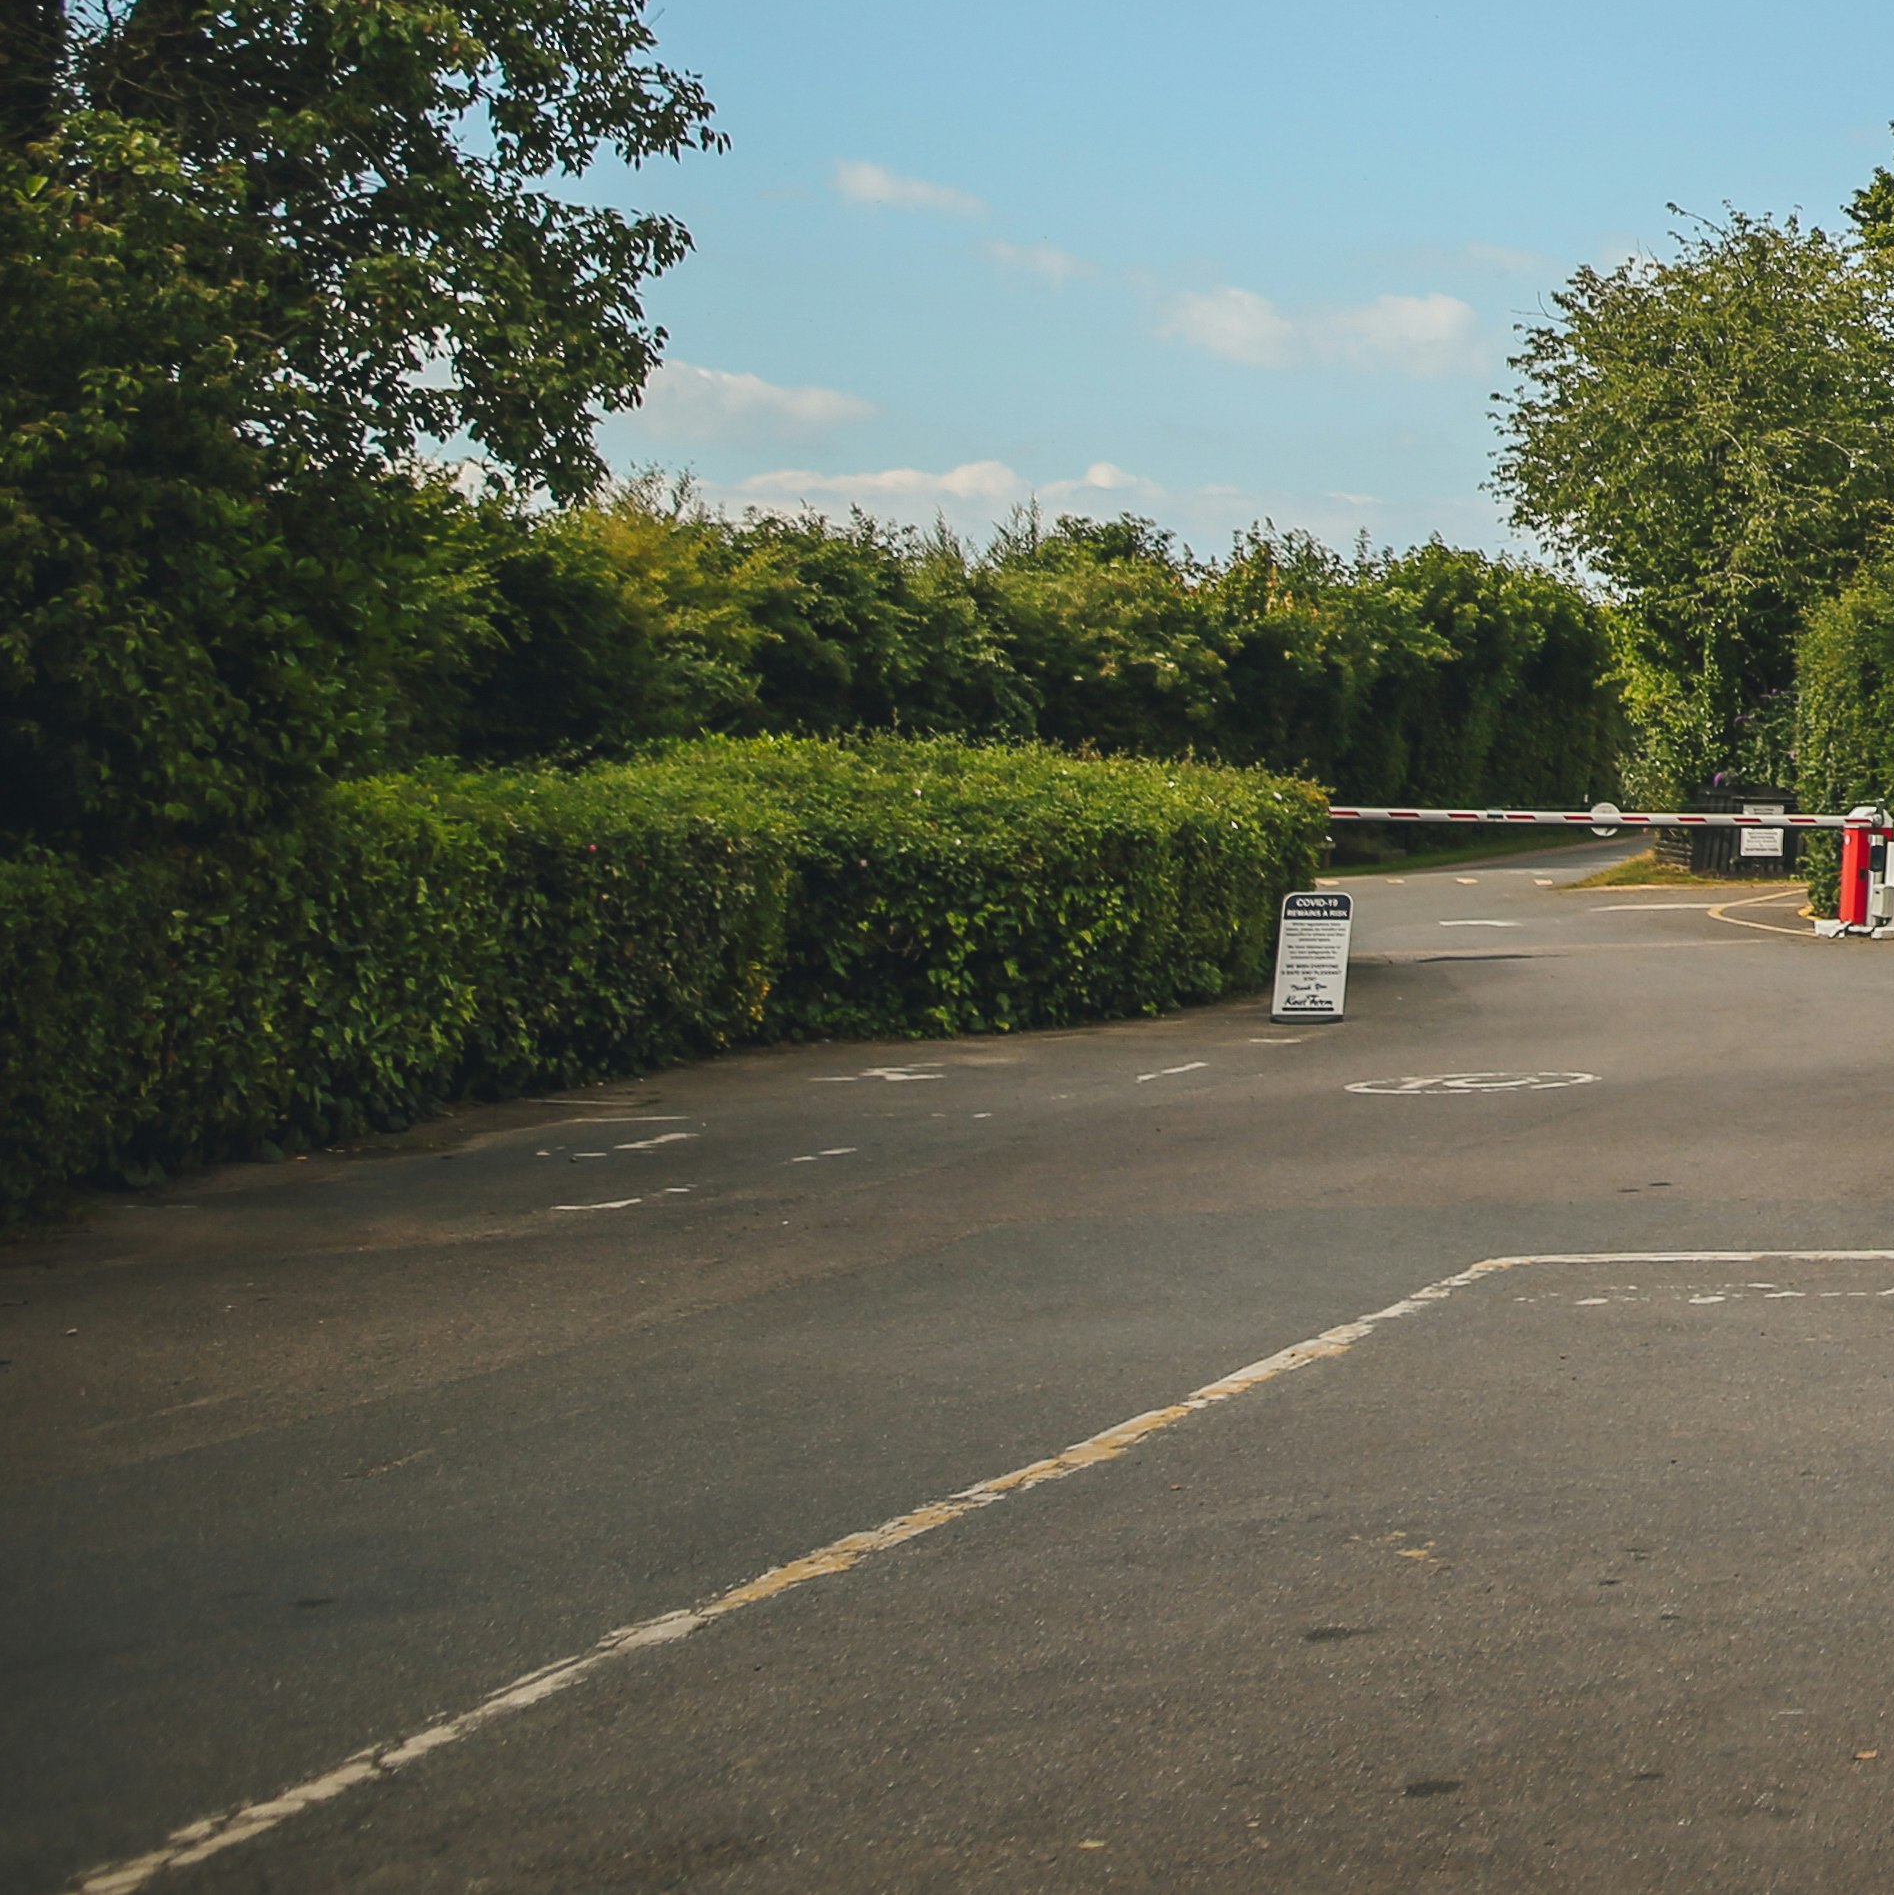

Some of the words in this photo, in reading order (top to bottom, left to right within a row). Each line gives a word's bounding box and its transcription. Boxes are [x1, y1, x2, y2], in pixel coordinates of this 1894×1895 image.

[1296, 898, 1339, 908] COVID-19
[1286, 909, 1321, 918] REMAINS
[1322, 910, 1328, 918] A
[1330, 910, 1348, 918] RISK
